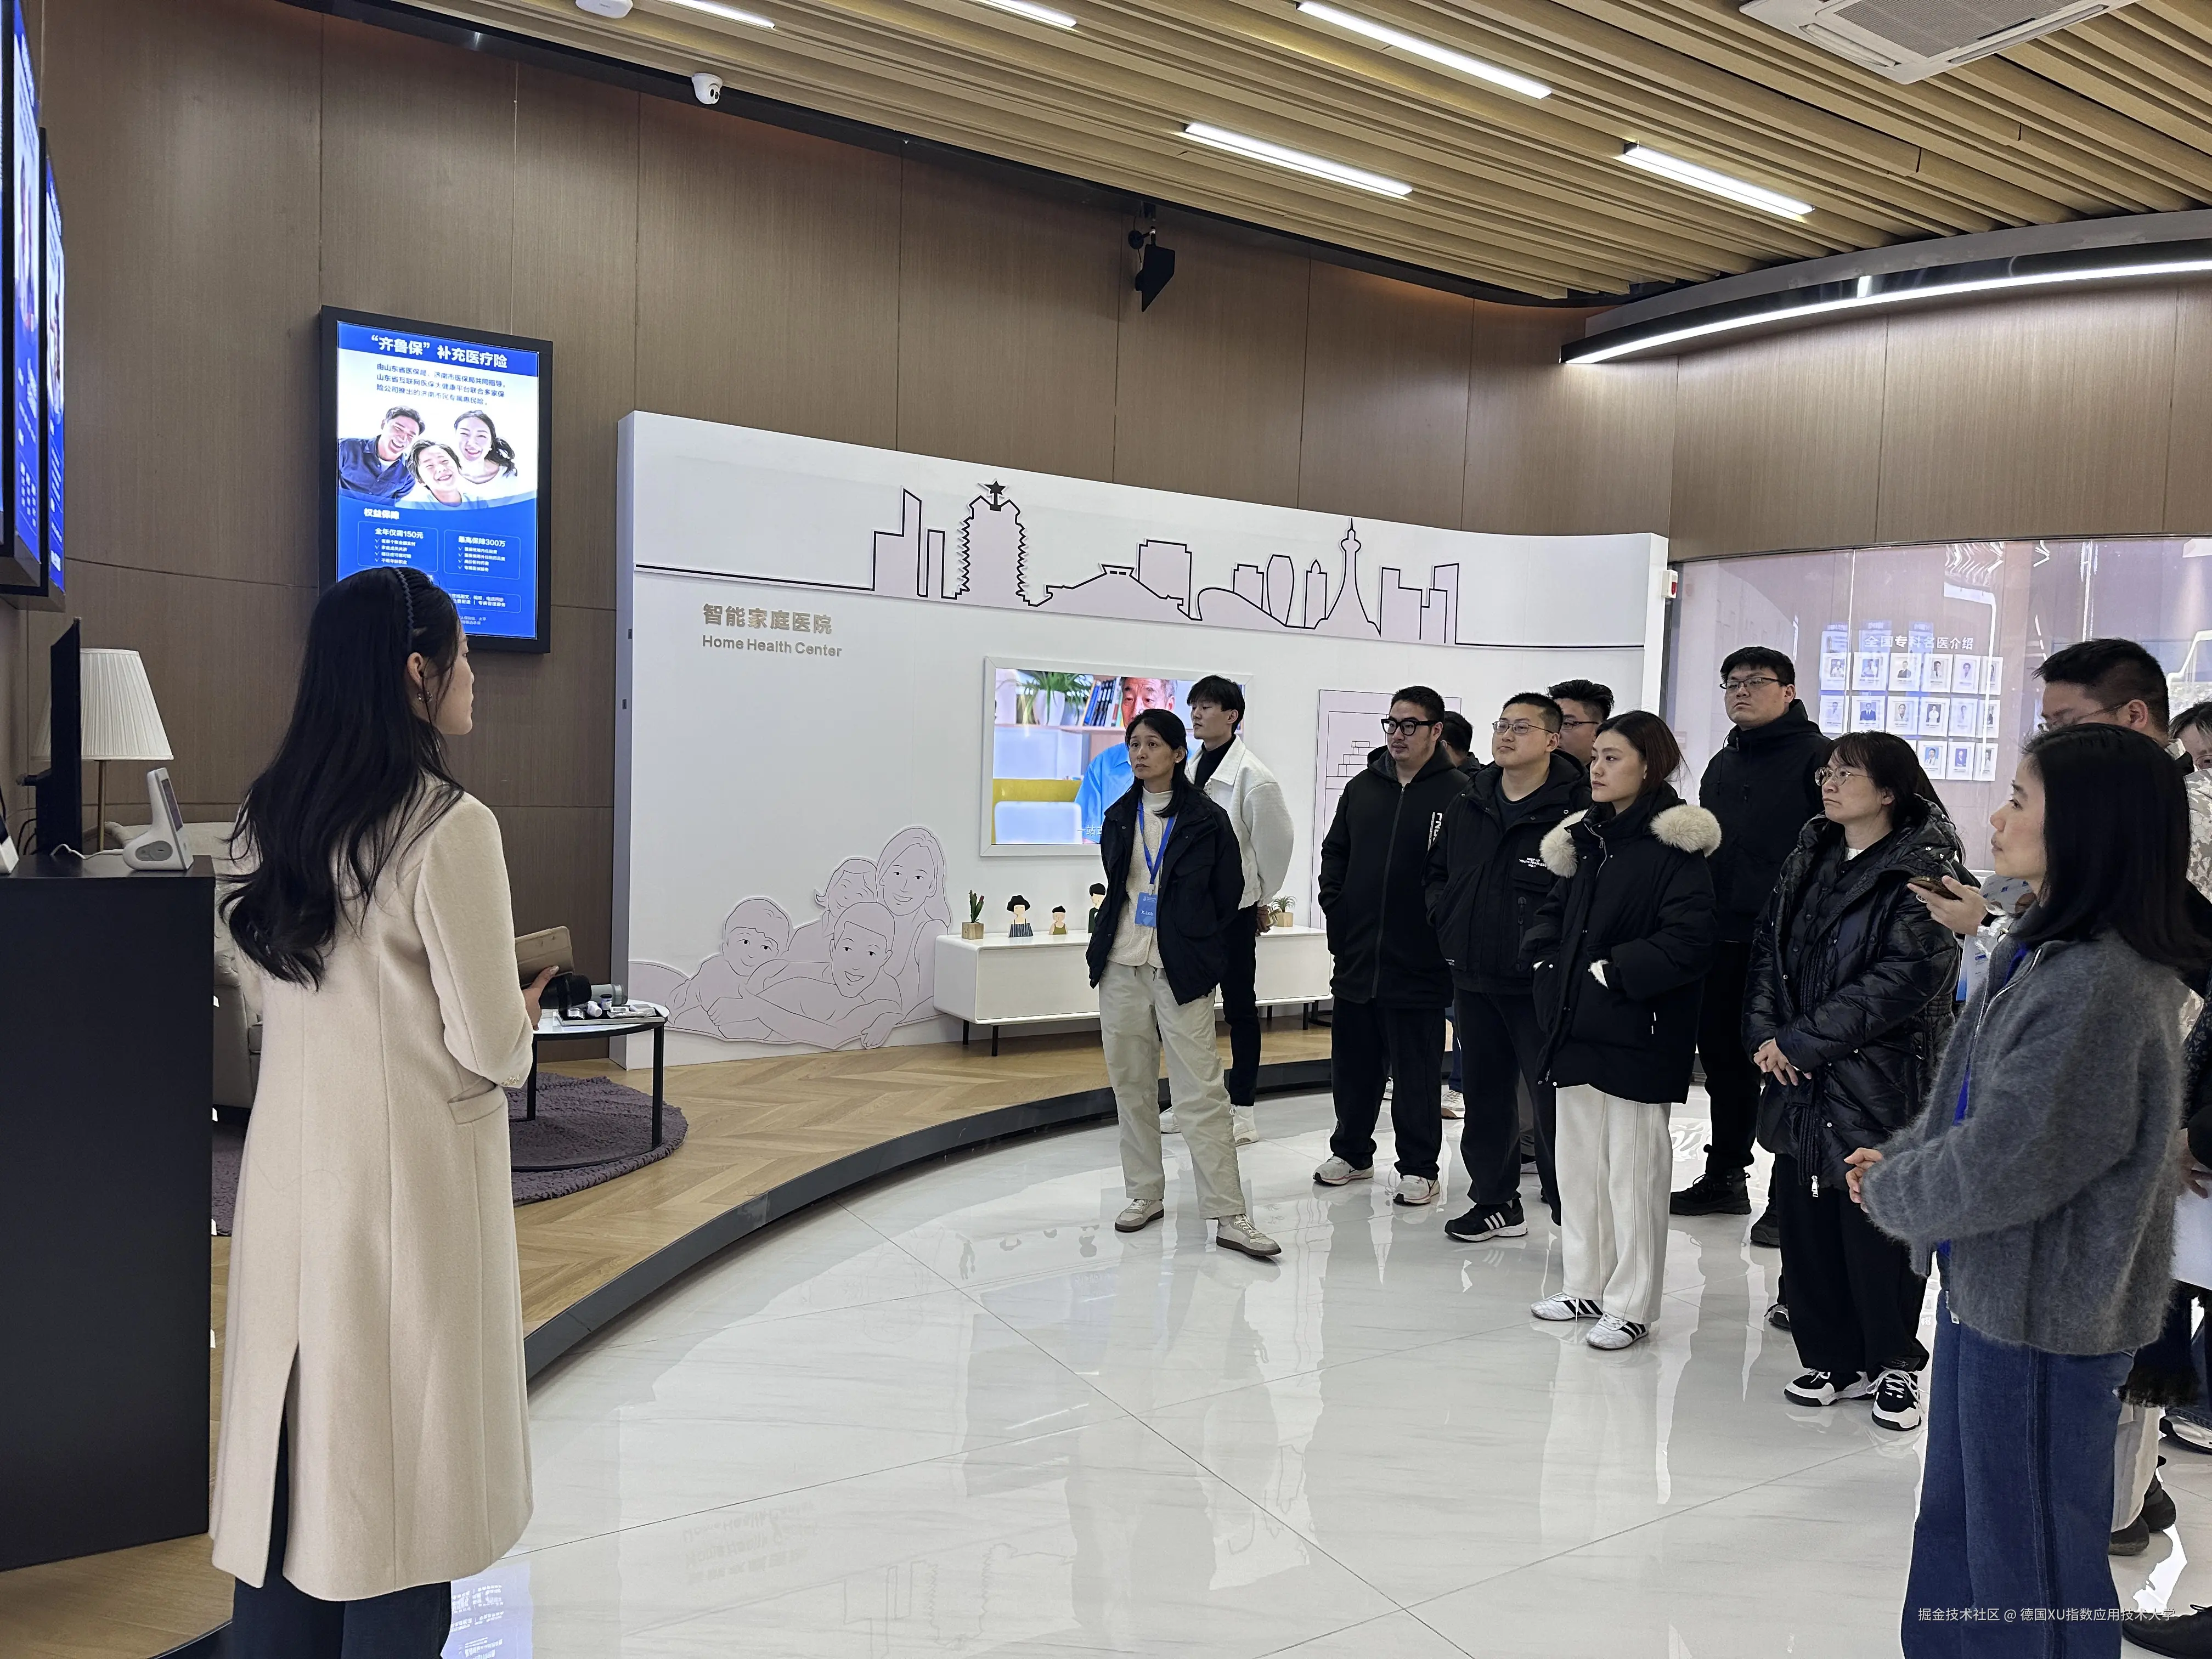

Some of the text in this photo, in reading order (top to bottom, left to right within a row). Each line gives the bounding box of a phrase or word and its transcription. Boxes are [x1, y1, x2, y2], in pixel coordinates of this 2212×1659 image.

[437, 345, 507, 368] 补充医疗险
[375, 527, 424, 539] 全年仅需150元
[703, 603, 832, 634] 智能家庭医院
[703, 635, 843, 657] Home Health Center
[1865, 635, 1974, 650] 全国专科名医介绍
